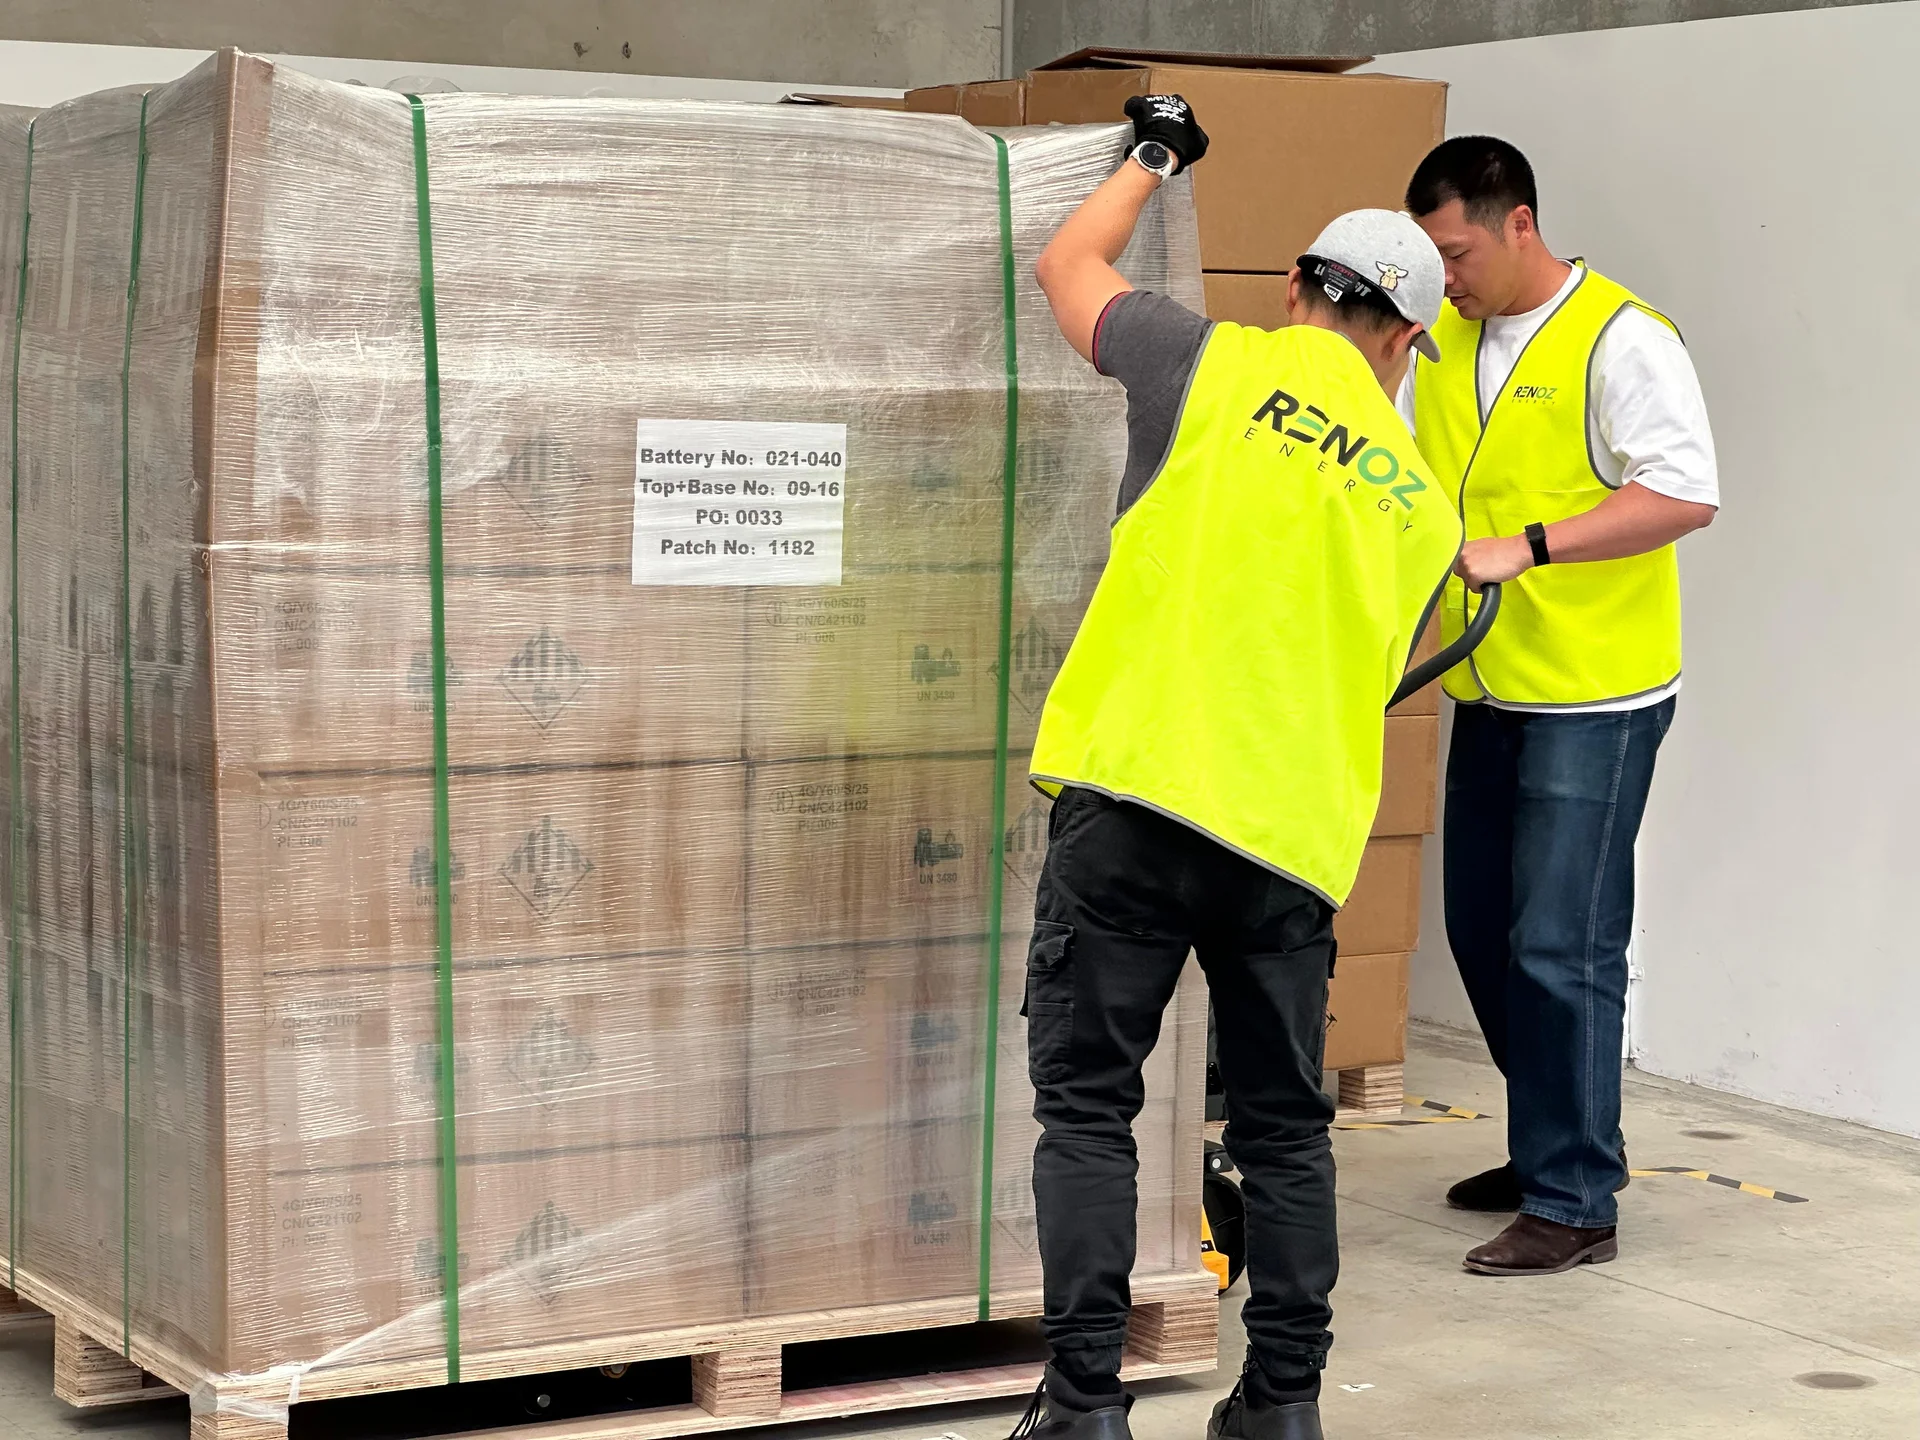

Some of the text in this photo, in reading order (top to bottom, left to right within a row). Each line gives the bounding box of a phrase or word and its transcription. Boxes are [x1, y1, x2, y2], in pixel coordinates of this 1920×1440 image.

[1513, 386, 1558, 400] RENOZ
[640, 448, 842, 468] Battery No: 021-040
[1251, 389, 1428, 511] RENOZ
[639, 478, 840, 497] Top+Base No: 09-16
[1244, 427, 1413, 533] ENERGY
[696, 509, 783, 526] PO: 0033
[661, 539, 815, 556] Patch No: 1182
[920, 873, 934, 885] UN
